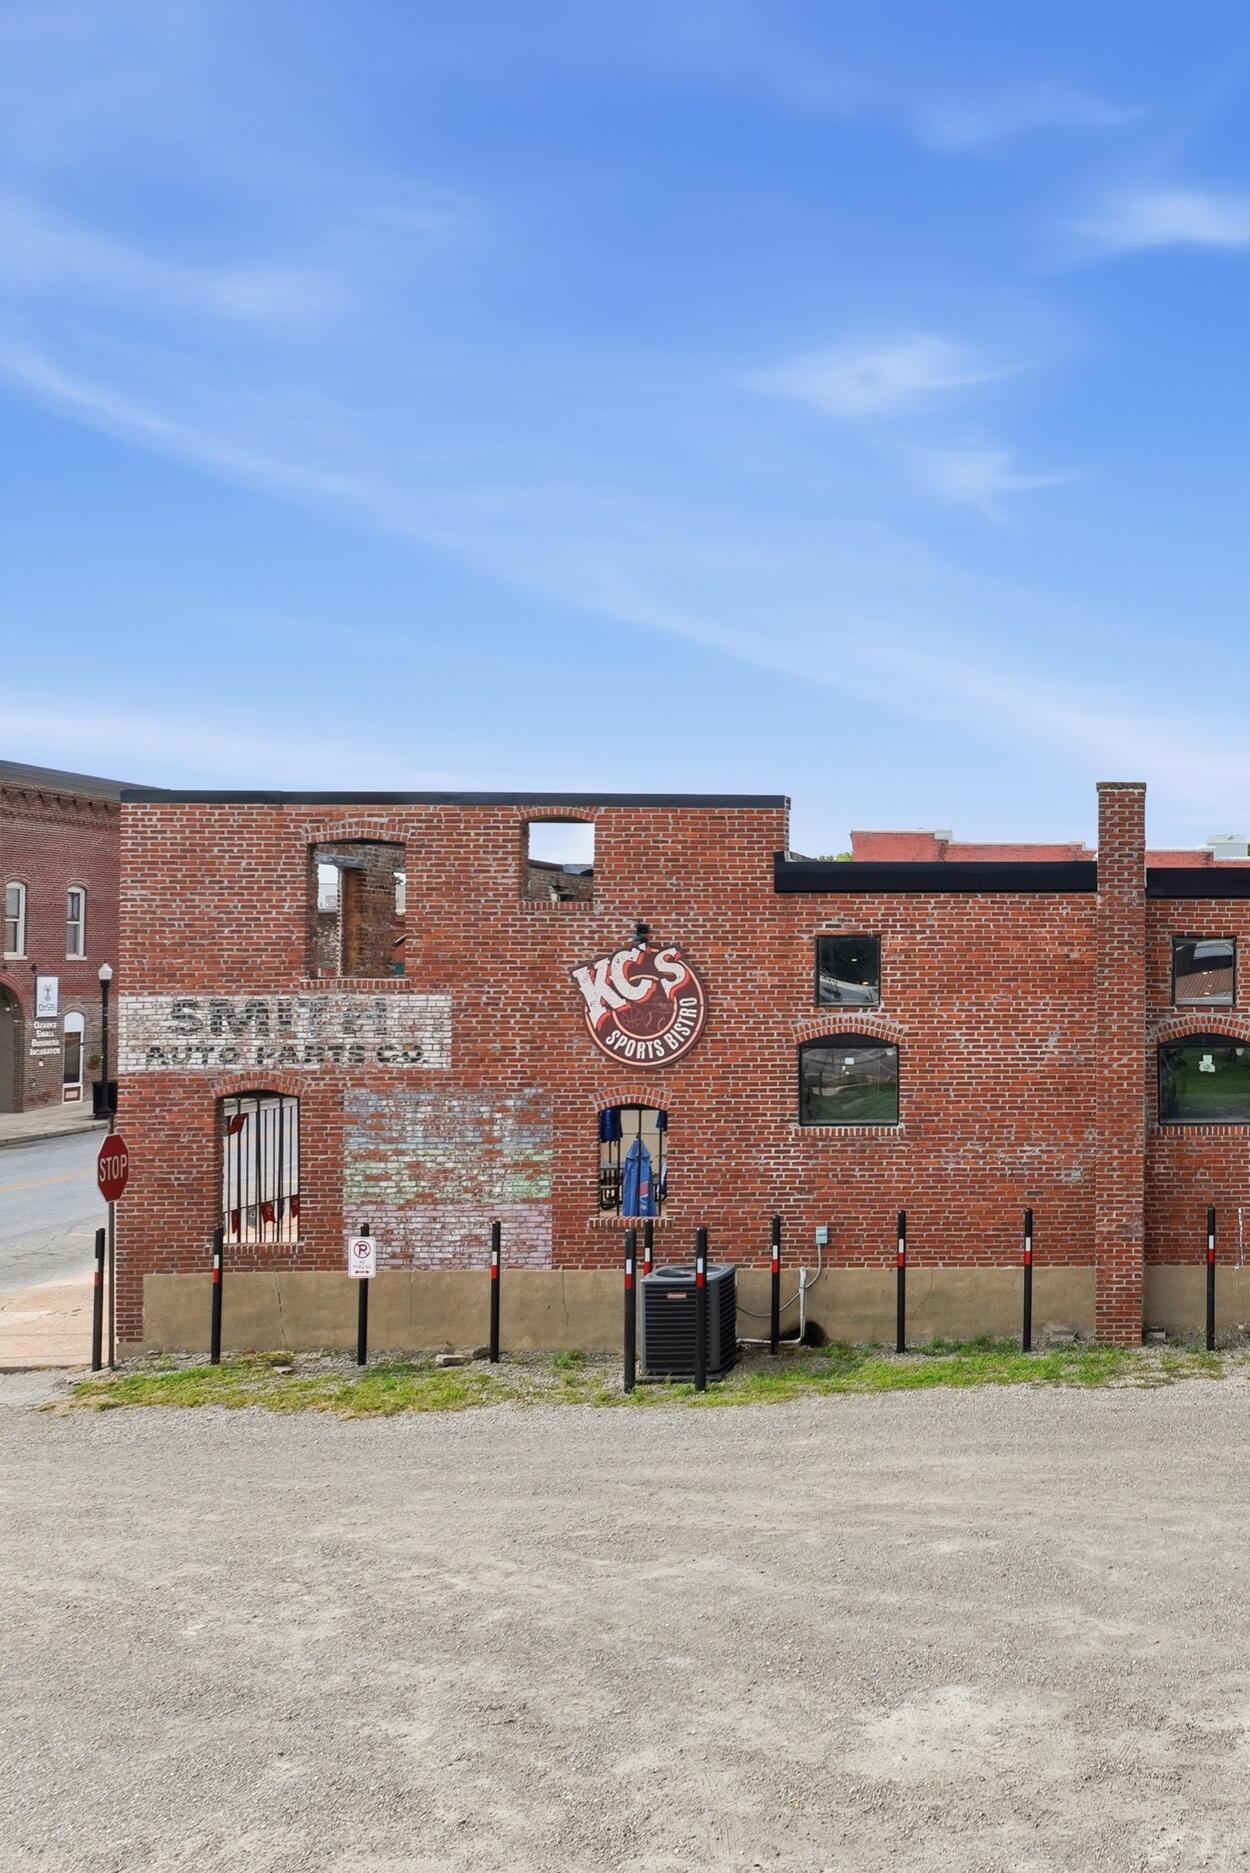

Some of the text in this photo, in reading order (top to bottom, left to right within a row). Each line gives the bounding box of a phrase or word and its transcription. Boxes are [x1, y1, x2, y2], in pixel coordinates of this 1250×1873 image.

[168, 998, 388, 1037] SMITH
[605, 996, 698, 1060] SPORTS BISTRO
[145, 1046, 240, 1066] AUTO
[256, 1045, 366, 1065] PARTS
[99, 1154, 128, 1182] STOP
